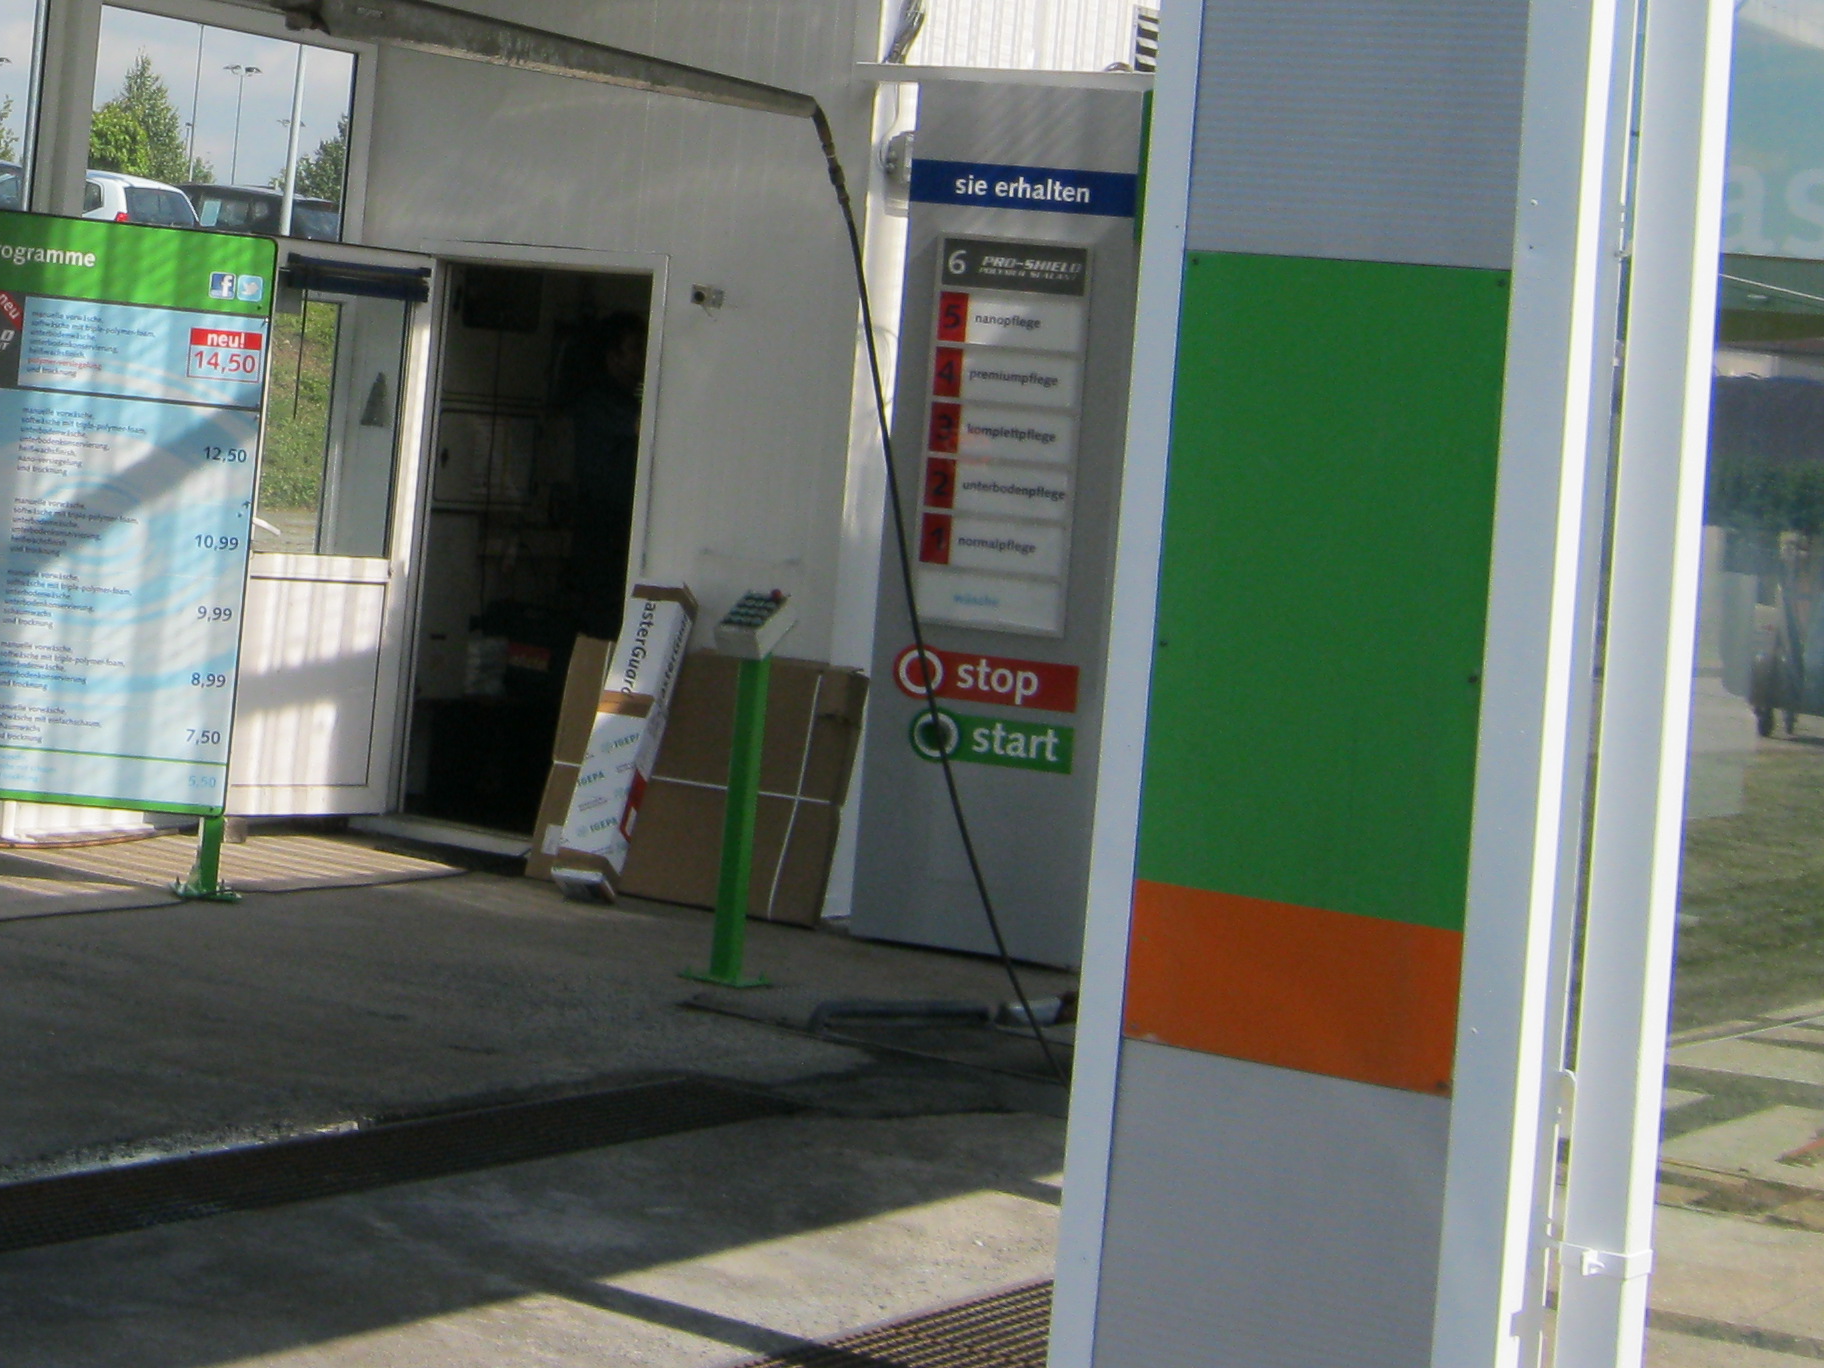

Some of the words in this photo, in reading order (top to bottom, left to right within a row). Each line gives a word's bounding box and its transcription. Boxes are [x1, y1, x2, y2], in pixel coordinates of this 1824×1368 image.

[954, 174, 988, 196] sie
[994, 176, 1091, 204] erhalten
[947, 249, 967, 275] 6
[981, 255, 1082, 273] PRO-SHIELD
[943, 304, 961, 329] 5
[975, 314, 1041, 330] nanopflege
[206, 332, 246, 349] neu!
[194, 350, 256, 374] 14,50
[938, 360, 955, 384] 4
[969, 369, 1059, 388] premiumpflege
[938, 413, 953, 440] 3
[967, 423, 1056, 445] komplettpflege
[203, 446, 247, 463] 12,50
[933, 470, 949, 496] 2
[962, 480, 1066, 502] unterbodenpflege
[194, 533, 239, 551] 10,99
[932, 526, 944, 551] 1
[957, 536, 1036, 555] normalpflege
[197, 605, 233, 622] 9,99
[621, 598, 657, 697] asterGuar
[190, 672, 226, 689] 8,99
[956, 658, 1039, 705] stop
[185, 729, 221, 745] 7,50
[971, 722, 1059, 762] start
[188, 775, 216, 789] 5,50
